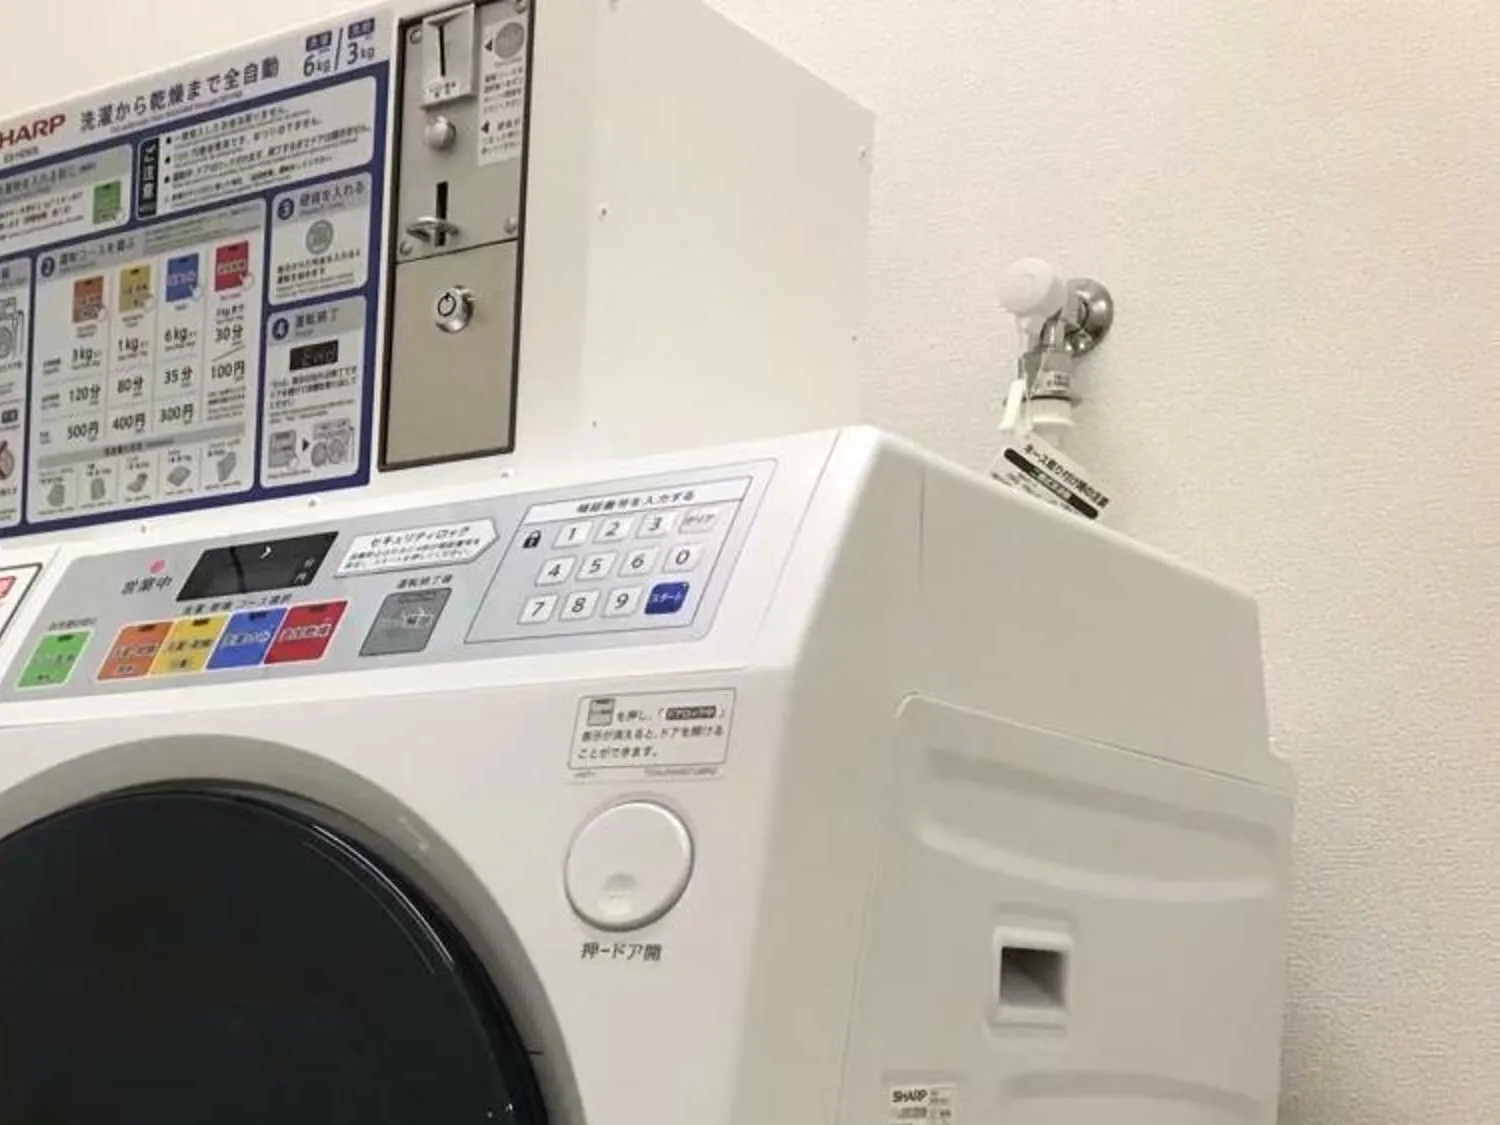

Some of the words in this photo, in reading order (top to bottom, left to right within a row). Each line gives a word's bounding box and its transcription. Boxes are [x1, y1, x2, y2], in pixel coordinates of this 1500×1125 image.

[80, 55, 280, 134] 洗濯から乾燥まで全自動
[210, 360, 245, 381] 100円
[68, 384, 101, 402] 120分
[111, 412, 146, 432] 400円
[605, 522, 620, 537] 2
[650, 517, 662, 532] 3
[371, 526, 470, 547] セキュリティロック
[631, 553, 644, 569] 6
[675, 549, 690, 565] 0
[549, 564, 560, 577] 4
[589, 558, 601, 573] 5
[121, 575, 173, 595] 営業中
[531, 601, 545, 616] 7
[571, 597, 586, 613] 8
[616, 593, 629, 609] 9
[578, 746, 658, 759] ことができます。
[892, 1089, 929, 1104] SHARP
